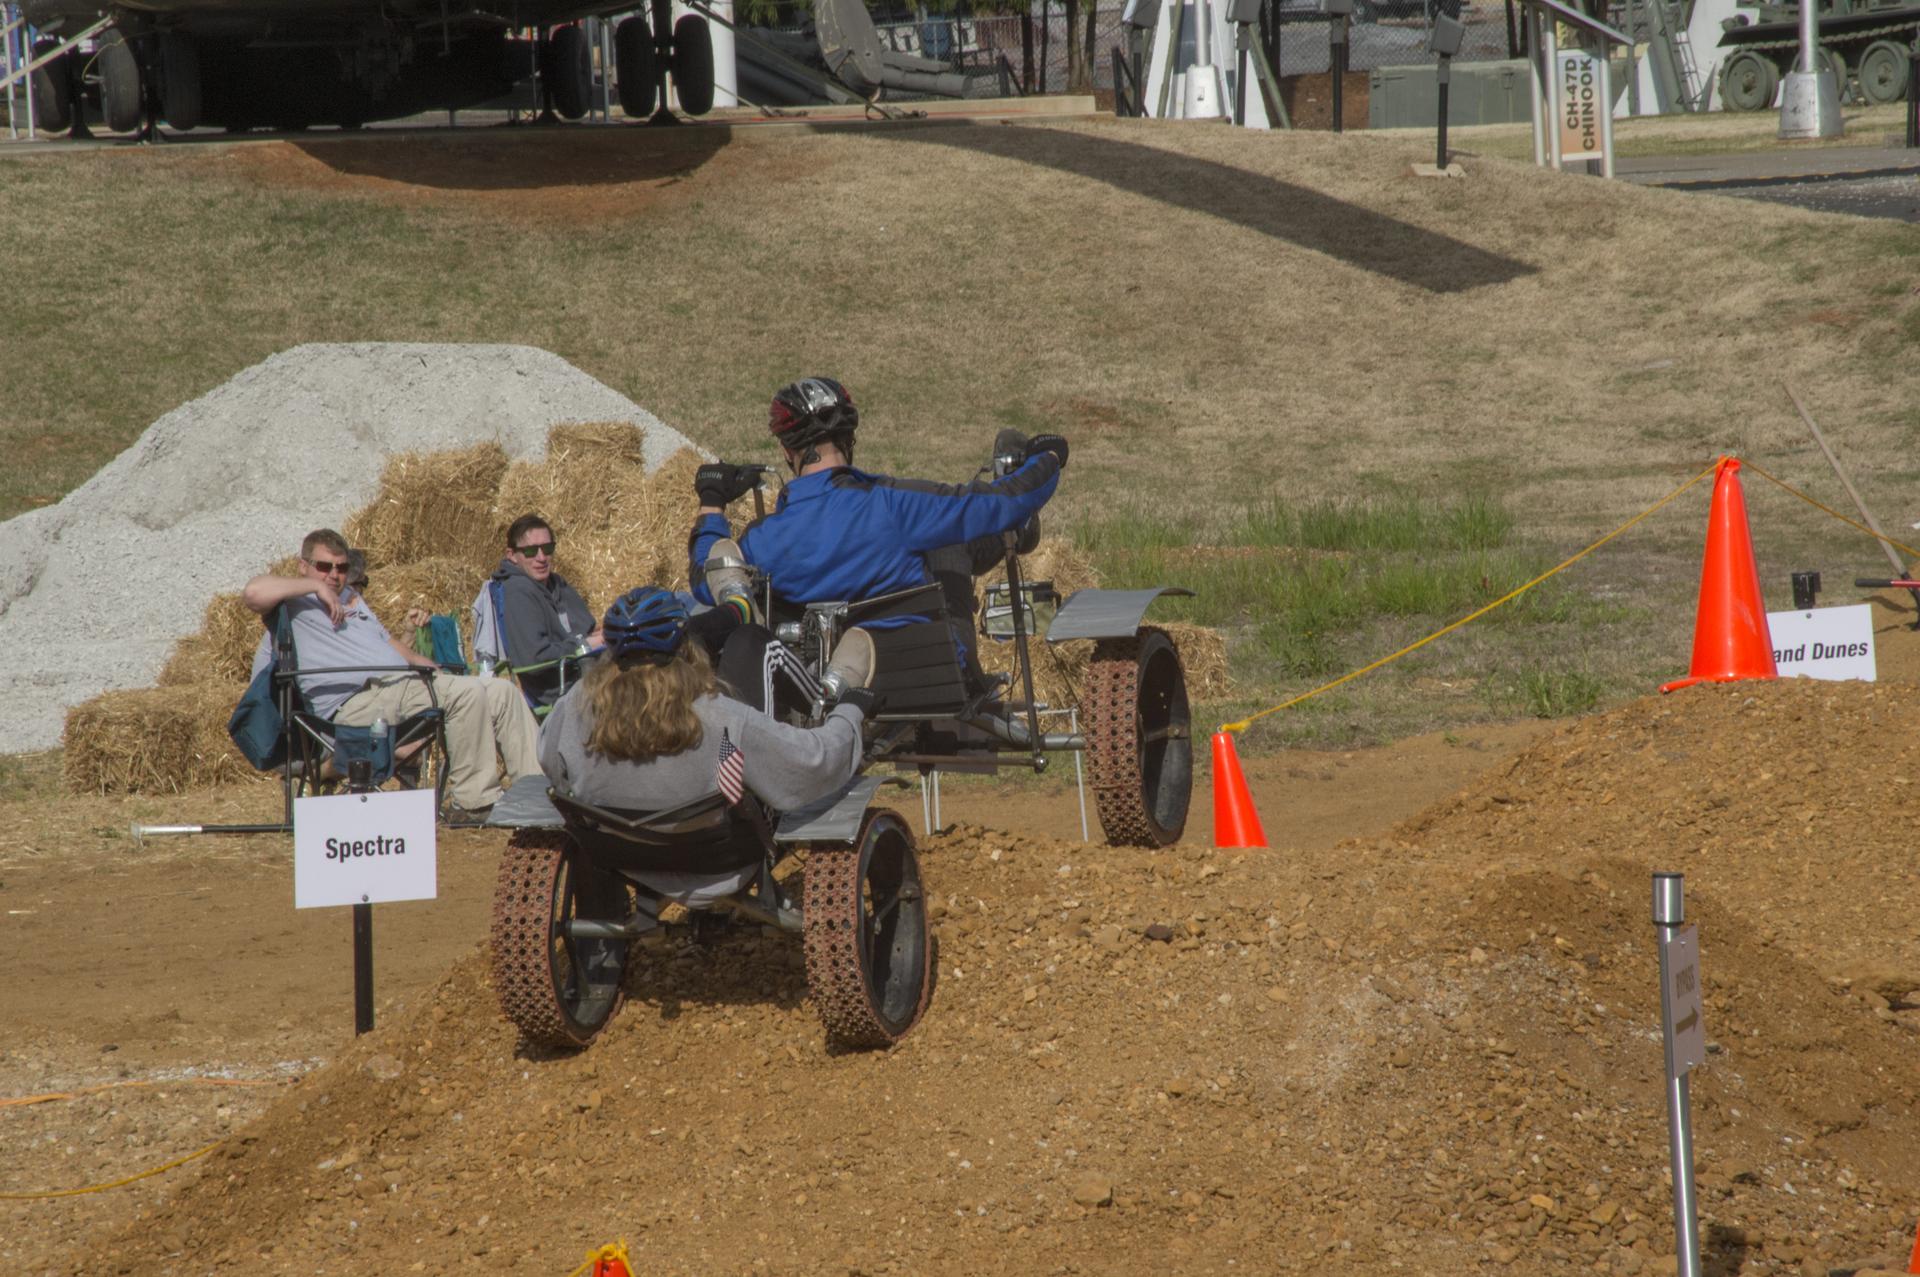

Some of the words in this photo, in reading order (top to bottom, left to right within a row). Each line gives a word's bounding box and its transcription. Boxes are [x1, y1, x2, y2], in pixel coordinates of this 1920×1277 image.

[1565, 59, 1579, 130] CH-47D
[1580, 58, 1595, 150] CHINOOK
[1773, 644, 1806, 663] and
[1812, 642, 1868, 660] Dunes
[325, 835, 406, 863] Spectra
